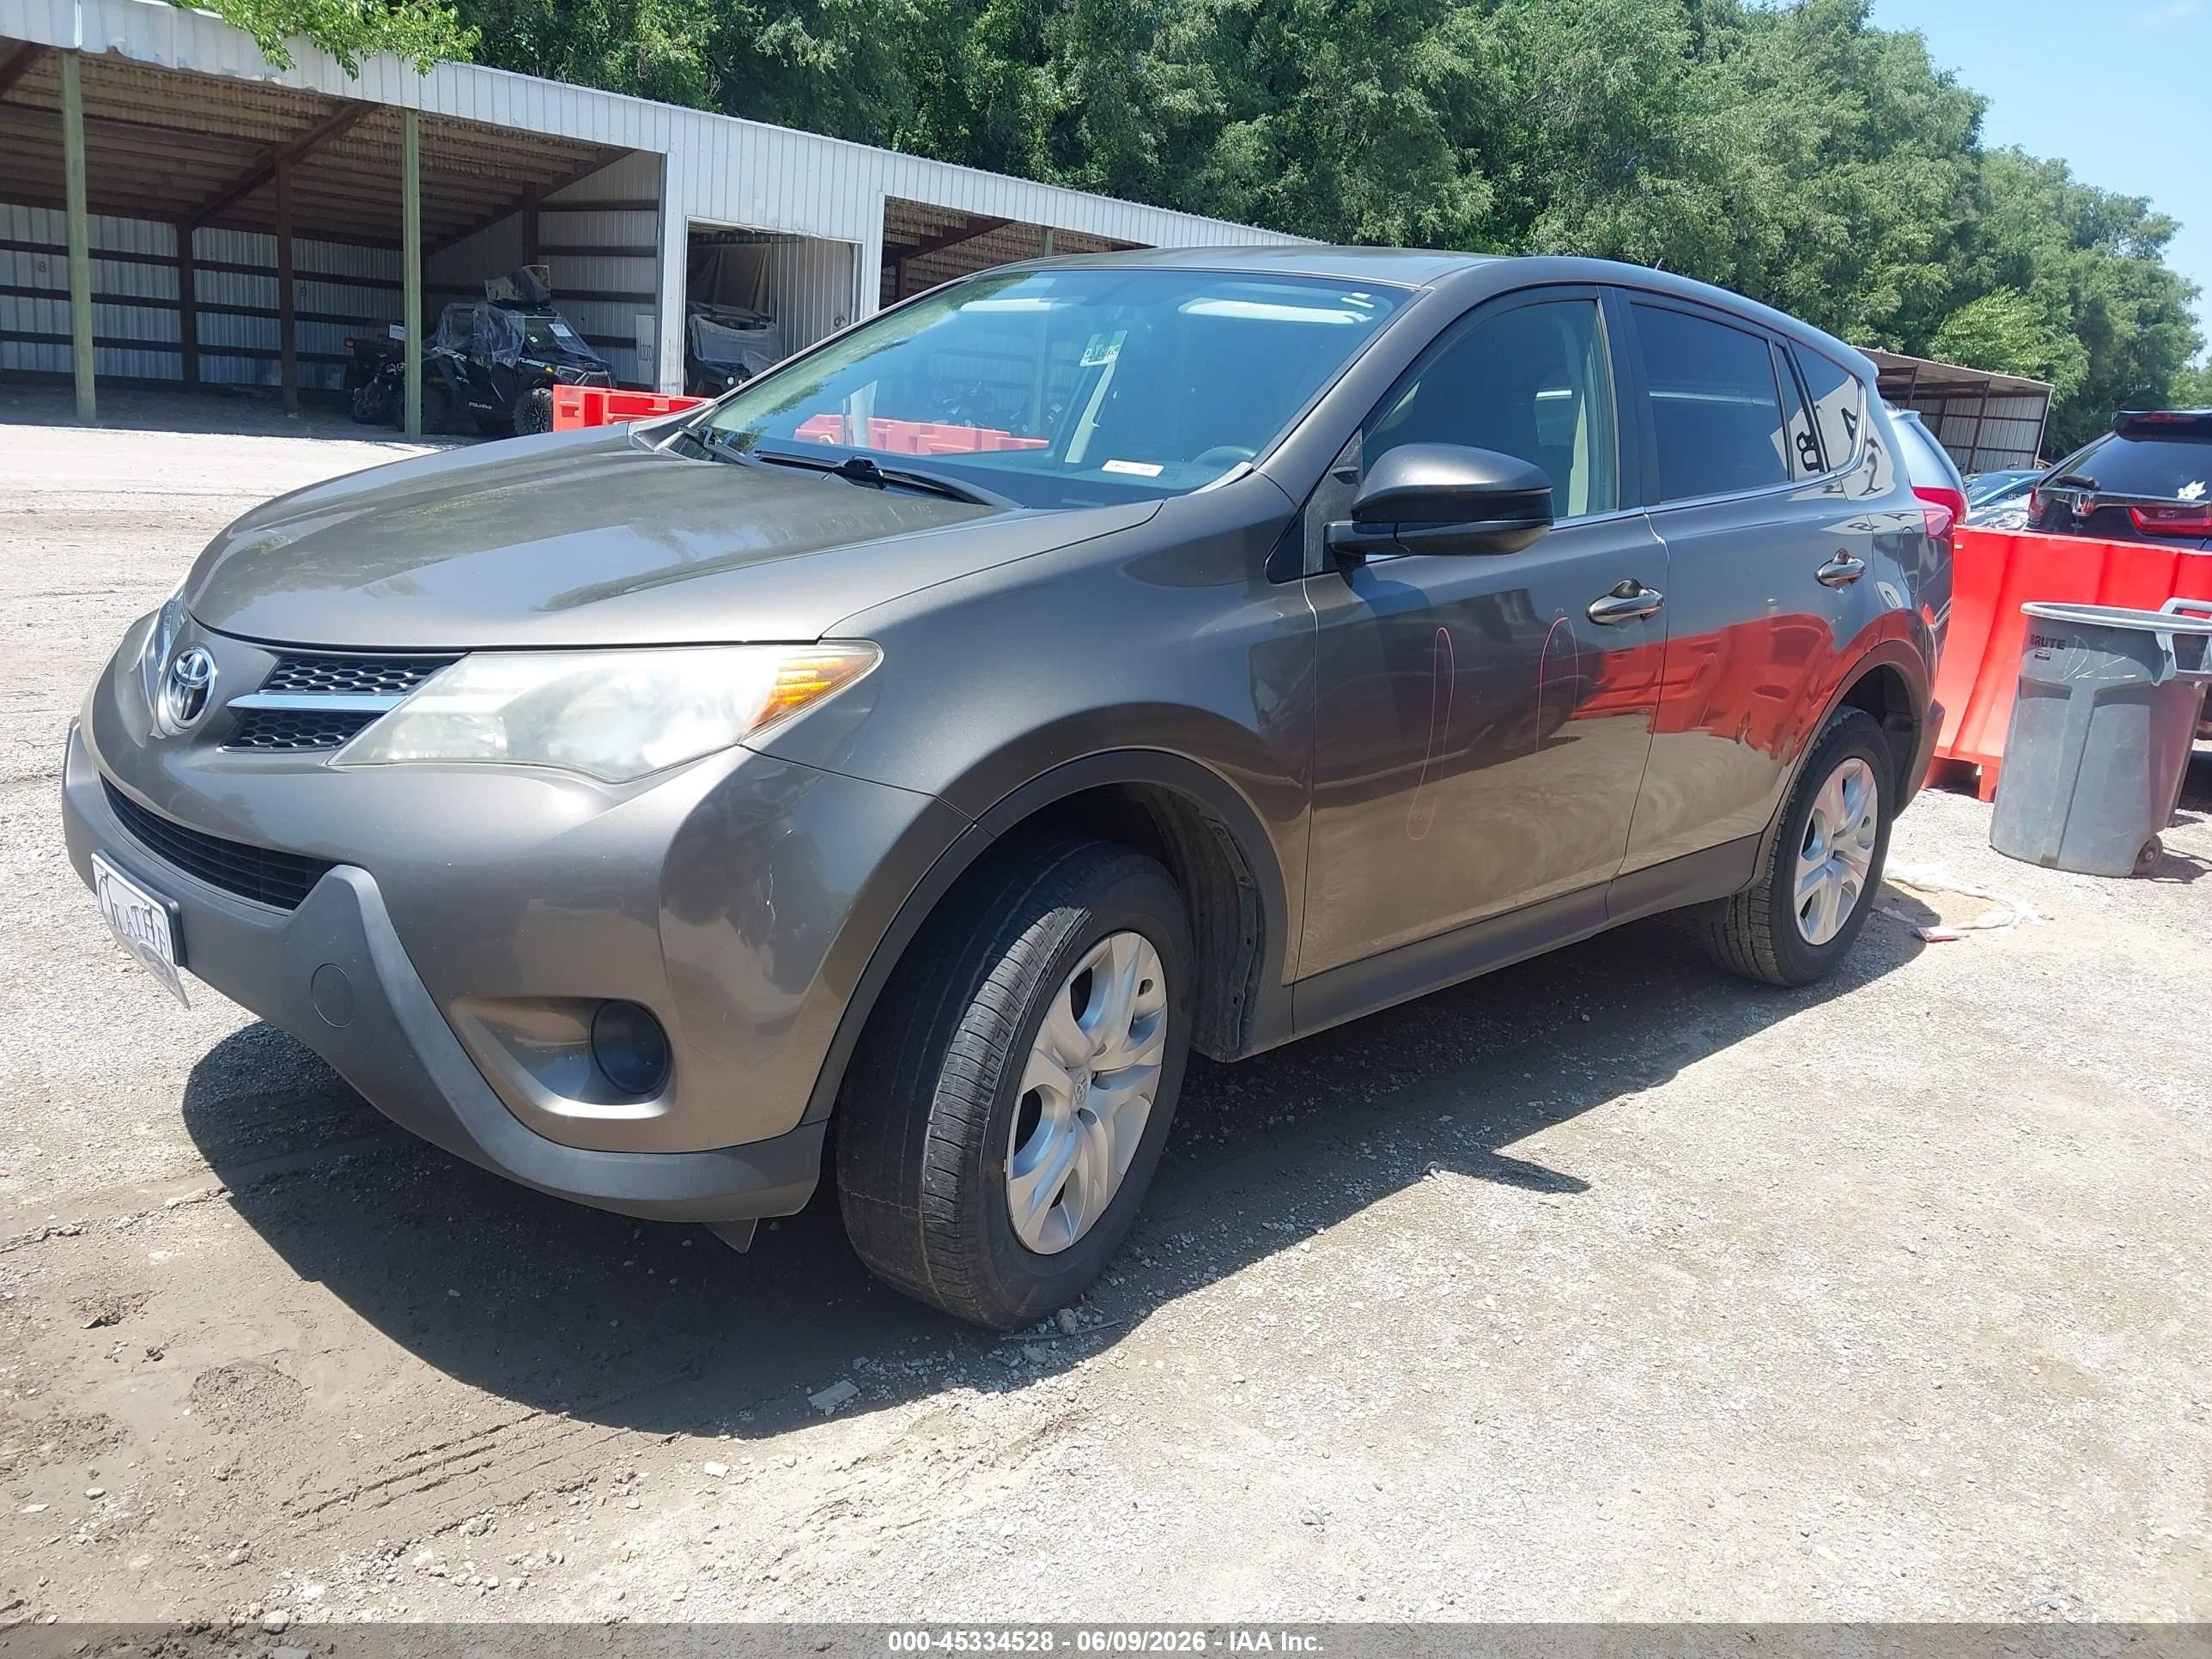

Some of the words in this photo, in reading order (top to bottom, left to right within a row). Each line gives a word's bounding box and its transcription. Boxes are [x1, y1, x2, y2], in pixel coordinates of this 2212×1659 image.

[517, 356, 546, 368] TURBO
[2029, 634, 2067, 650] BRUTE
[98, 875, 171, 963] OLATHE
